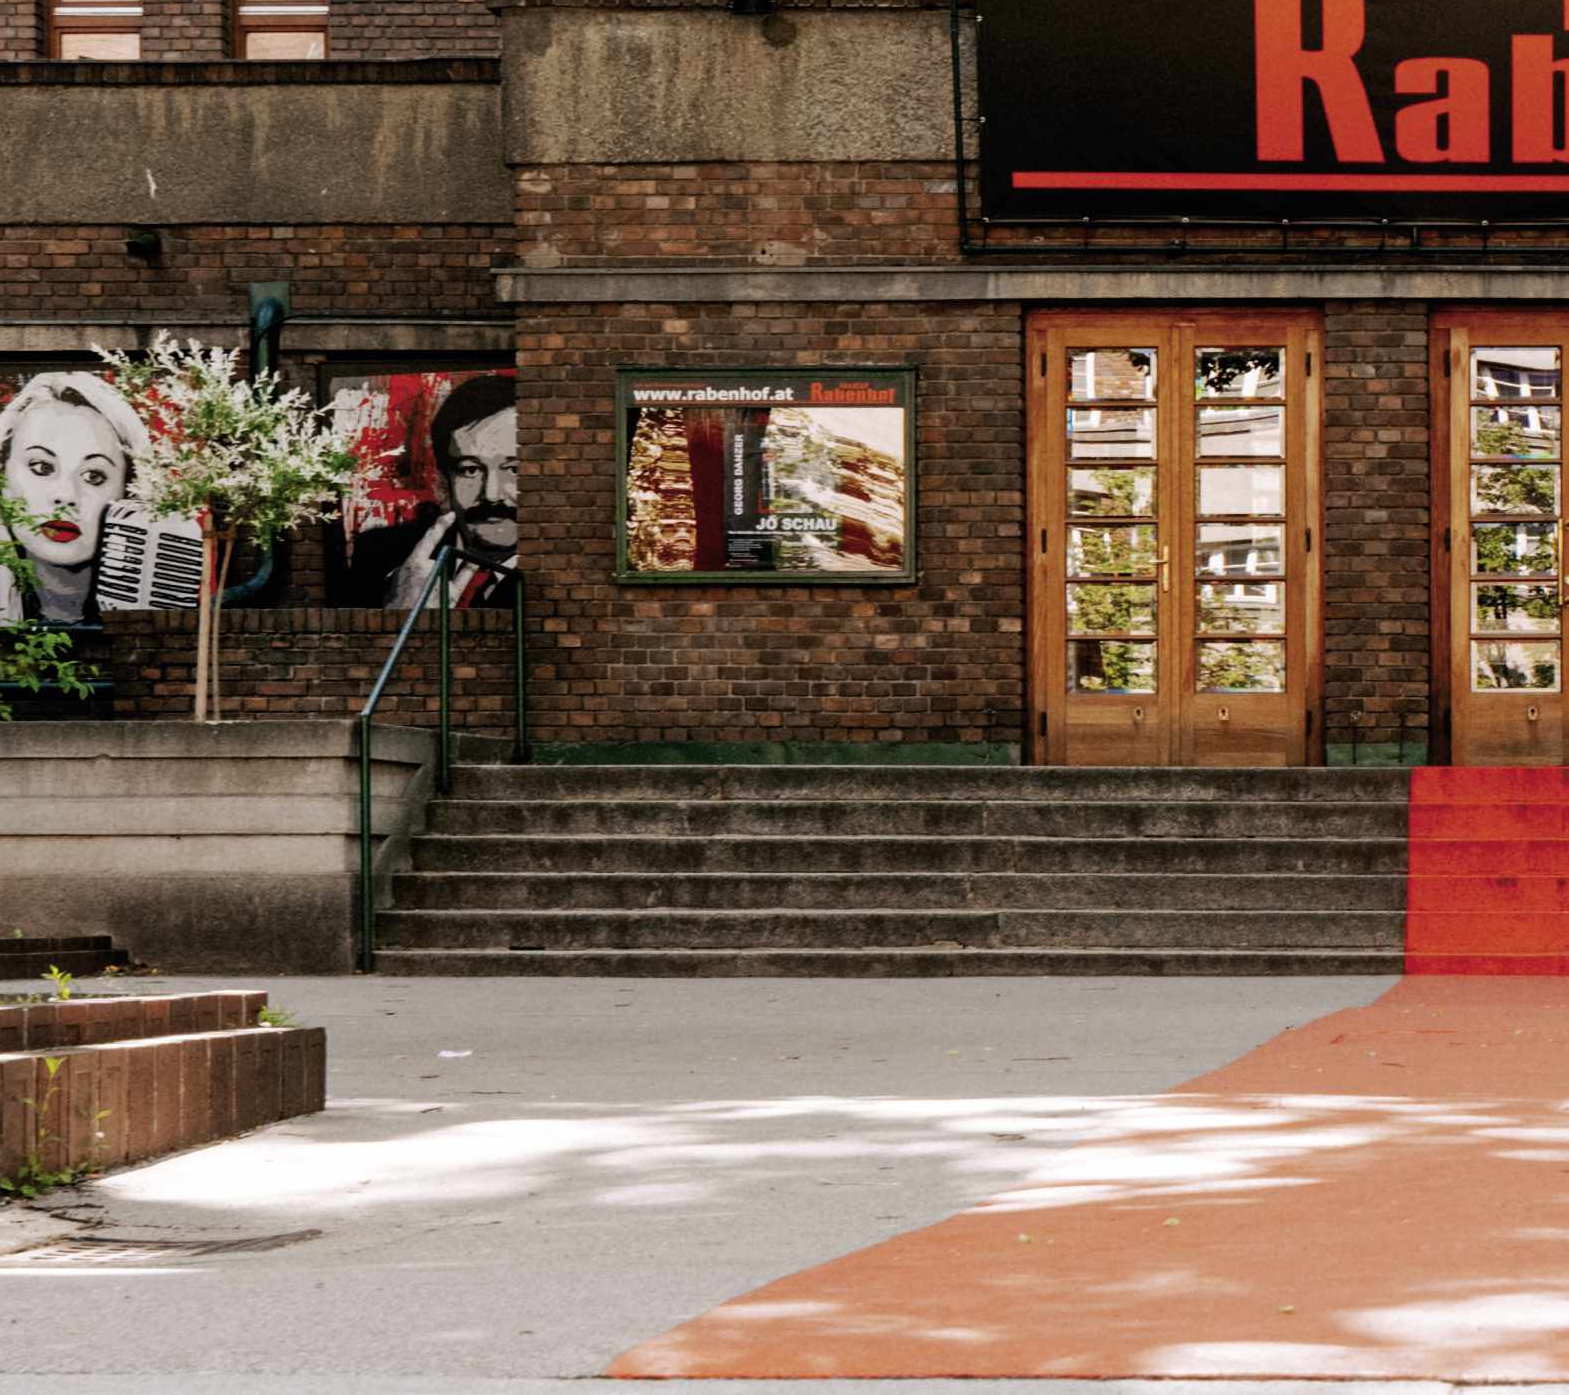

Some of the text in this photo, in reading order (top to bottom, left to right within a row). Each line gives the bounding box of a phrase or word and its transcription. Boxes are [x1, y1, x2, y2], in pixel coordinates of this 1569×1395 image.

[633, 386, 794, 401] www.rabenhof.at
[809, 381, 895, 404] Rabenhof
[781, 517, 838, 530] SCHAU
